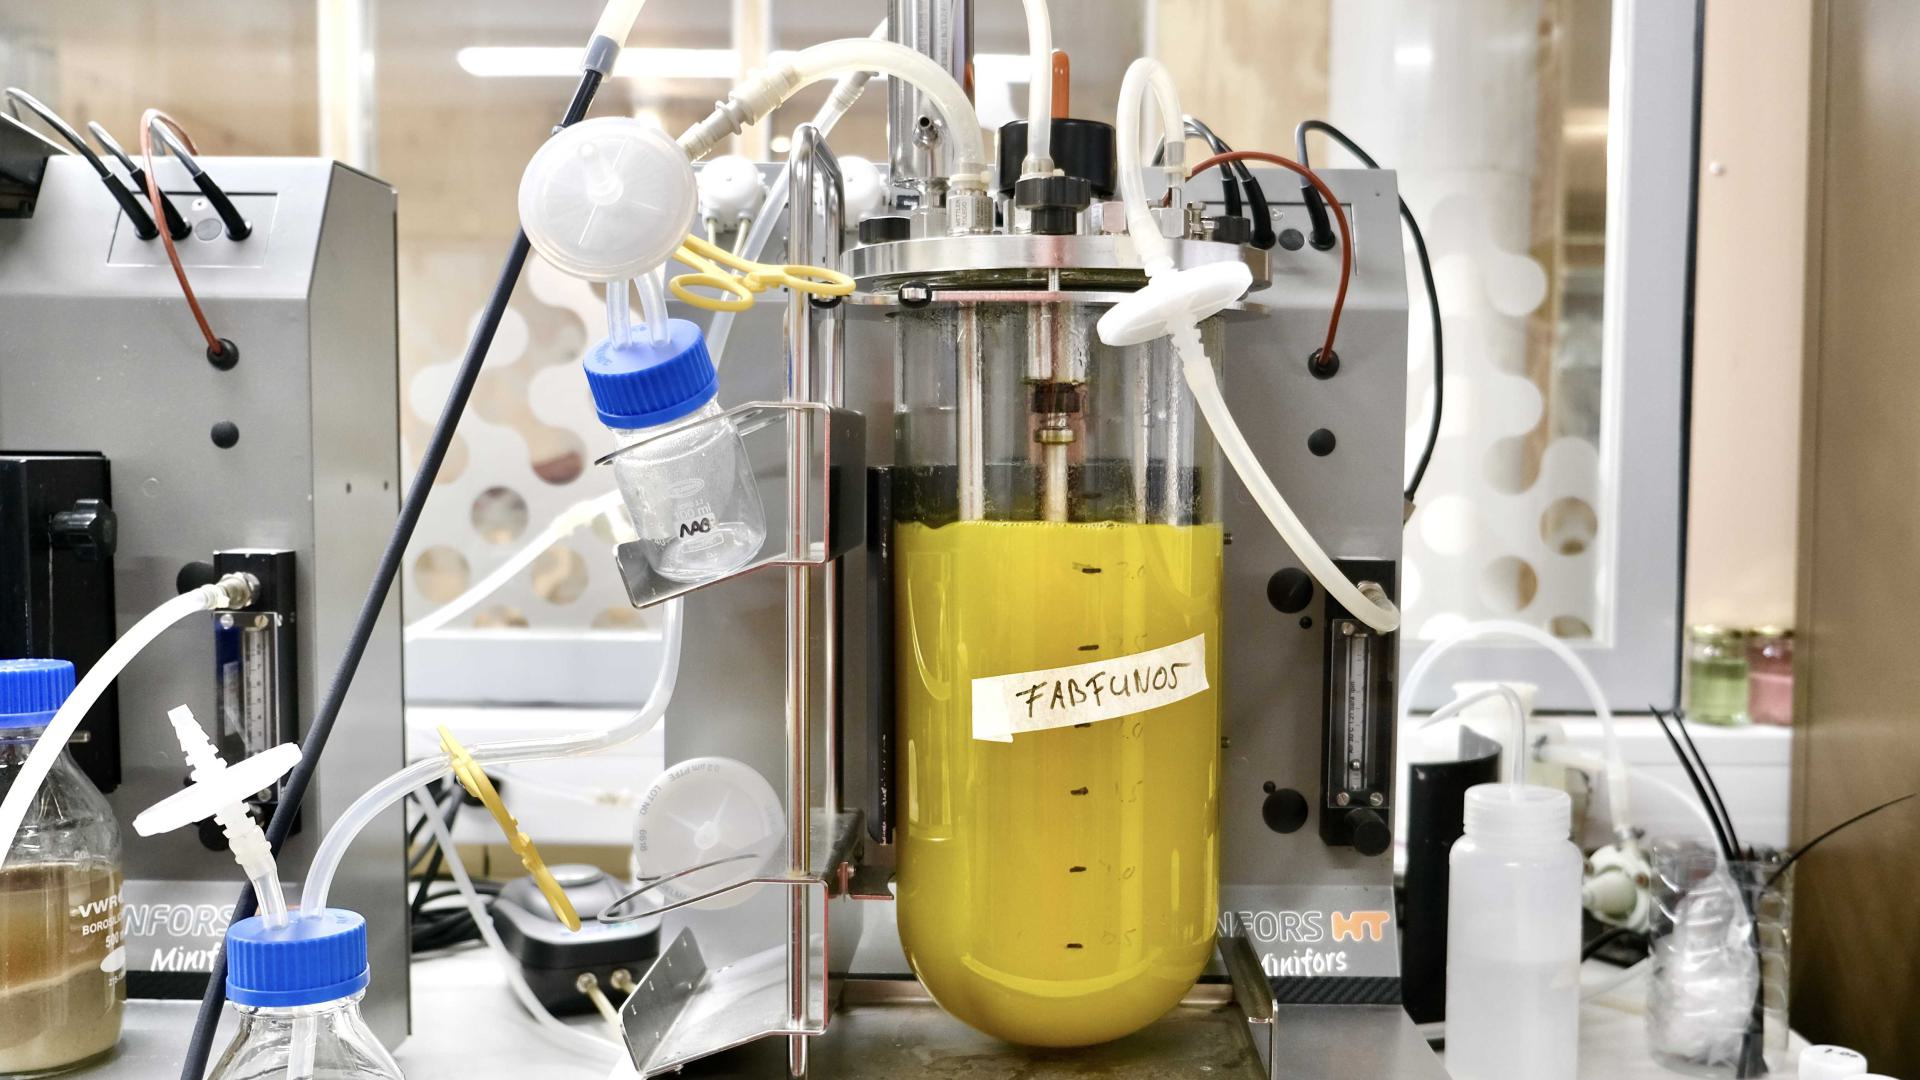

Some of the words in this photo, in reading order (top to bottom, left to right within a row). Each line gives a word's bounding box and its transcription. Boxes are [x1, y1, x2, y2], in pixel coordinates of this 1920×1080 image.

[123, 903, 236, 937] NFORS
[1216, 910, 1324, 943] NFORS
[150, 941, 223, 972] Minif
